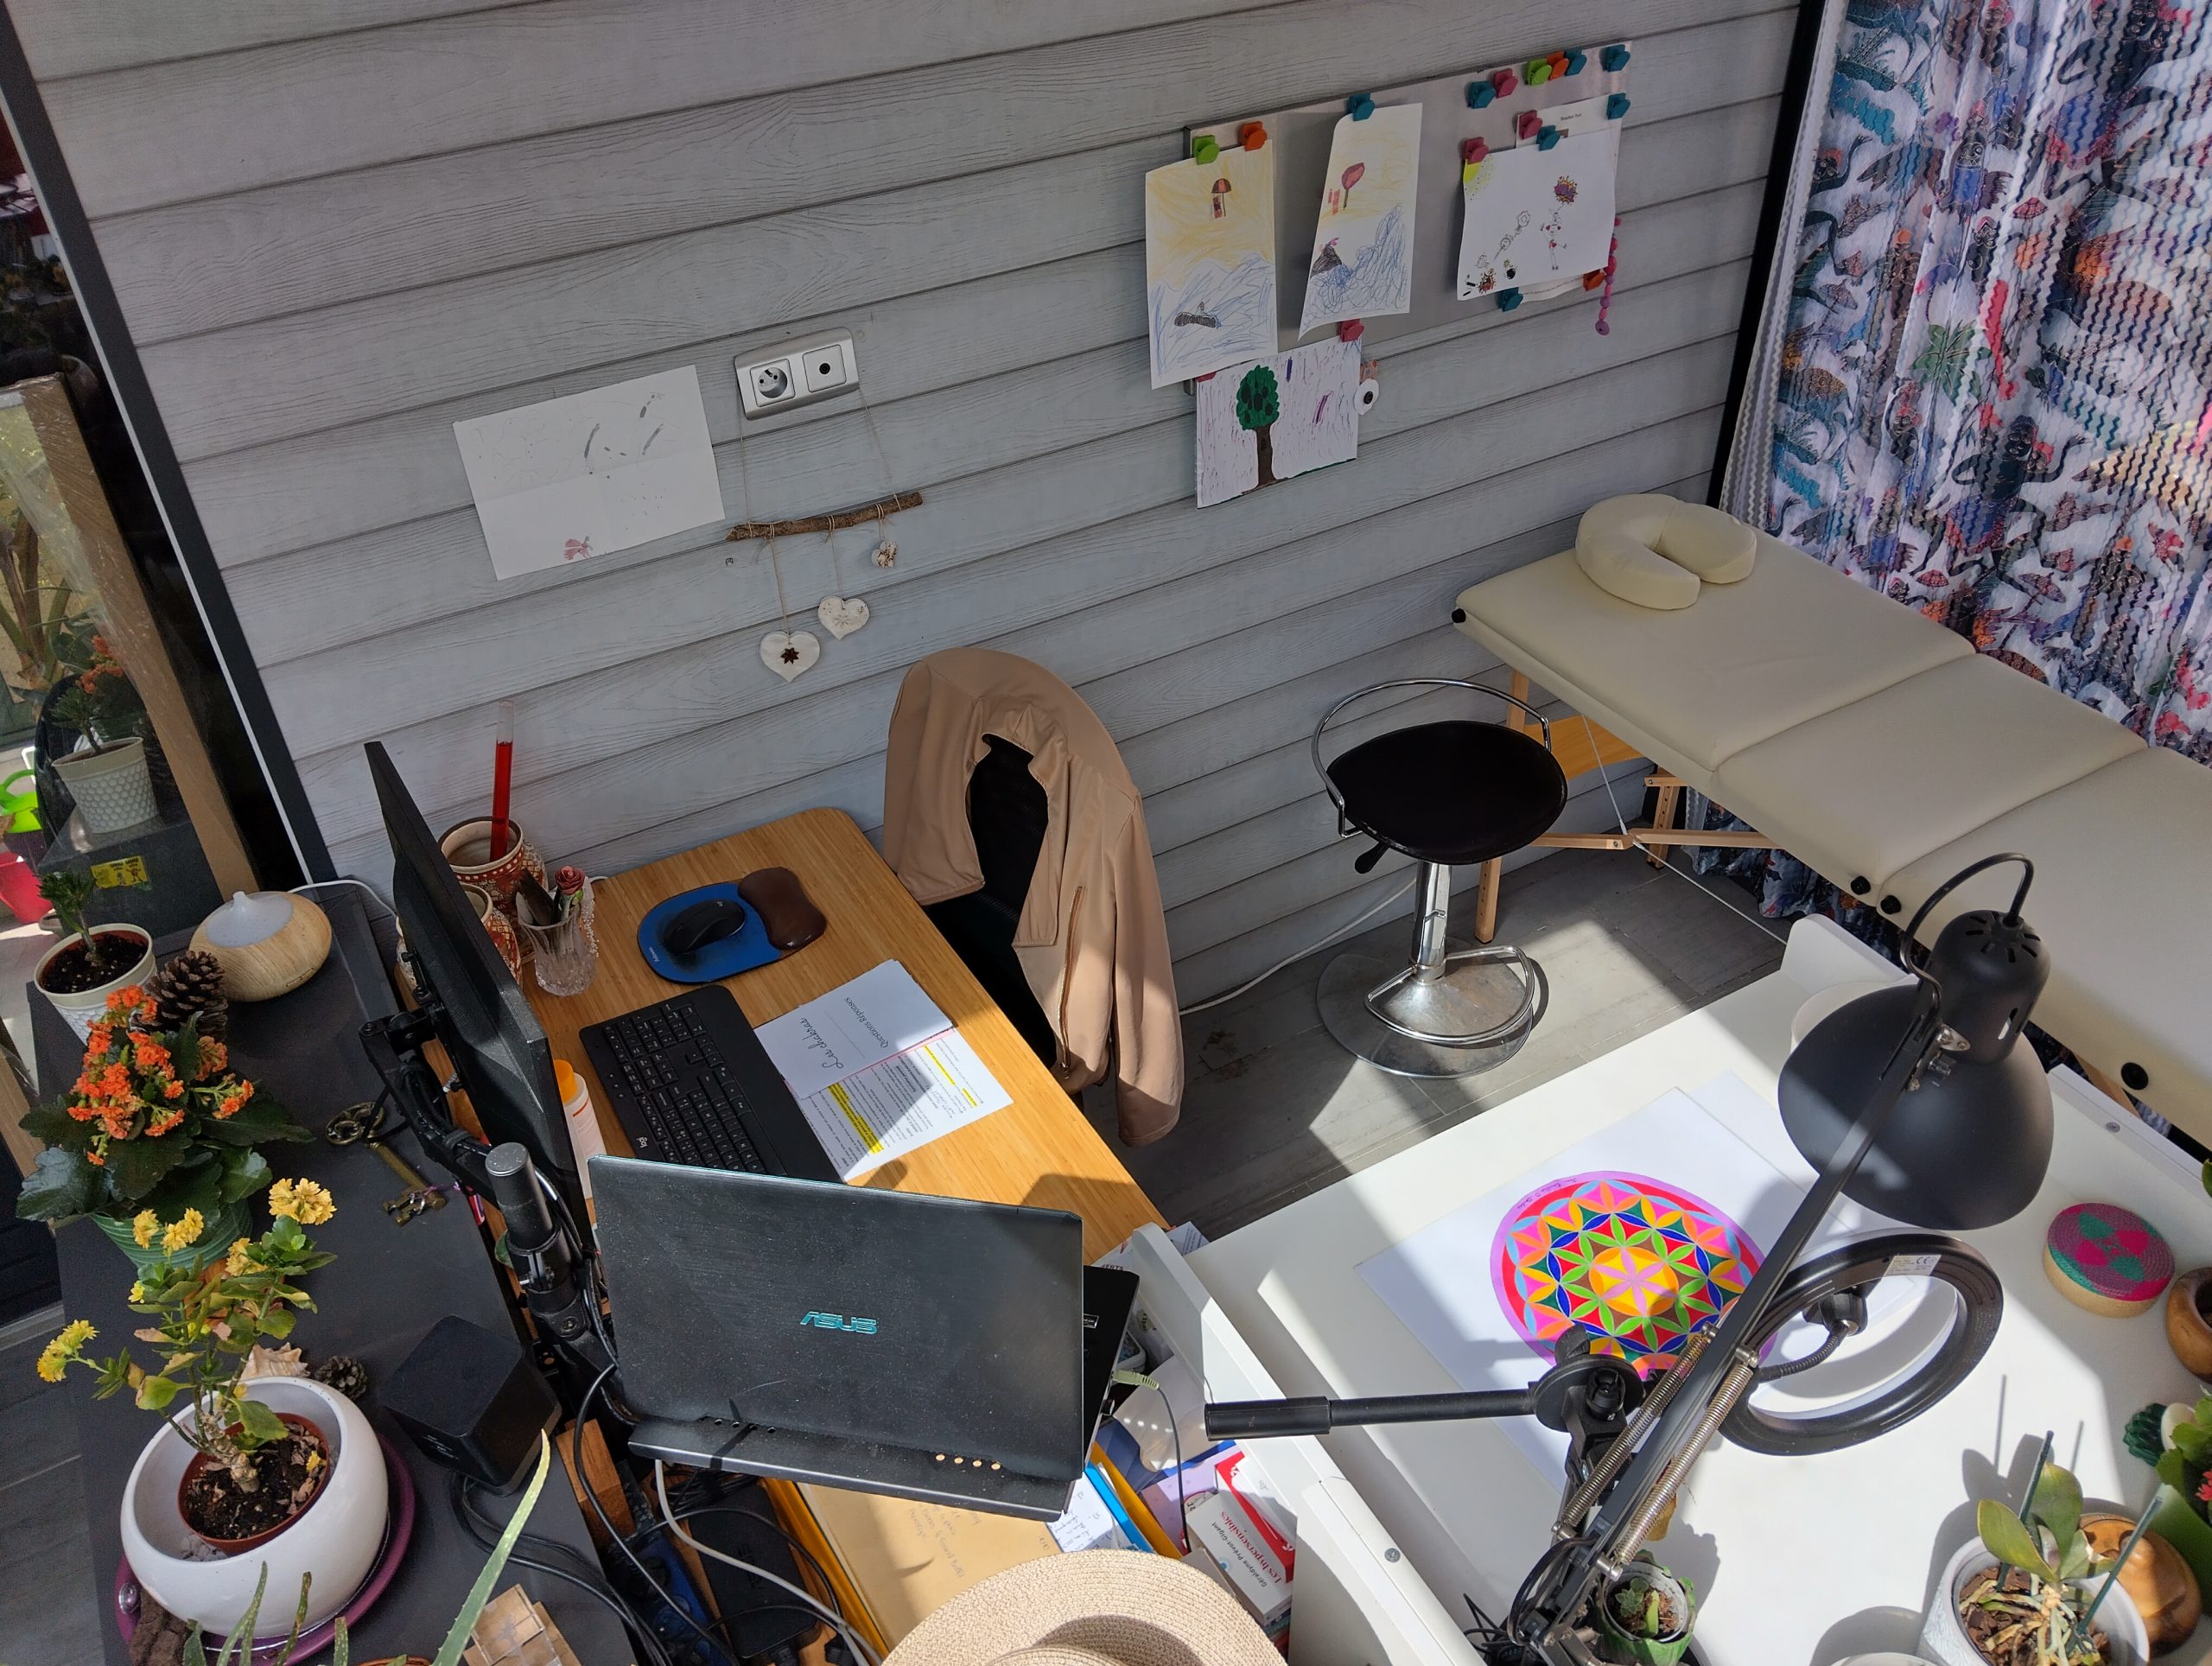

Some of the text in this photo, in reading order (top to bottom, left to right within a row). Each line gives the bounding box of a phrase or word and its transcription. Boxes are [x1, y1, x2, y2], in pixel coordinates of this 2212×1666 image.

[800, 1017, 827, 1050] chakras
[844, 996, 889, 1049] Questions Réponses
[822, 1049, 844, 1069] Les
[635, 1136, 649, 1148] logi
[799, 1311, 878, 1334] ASUS
[1211, 1522, 1268, 1588] Géraldyne Prévot-Gigant
[1221, 1510, 1282, 1584] Les hypersensibles
